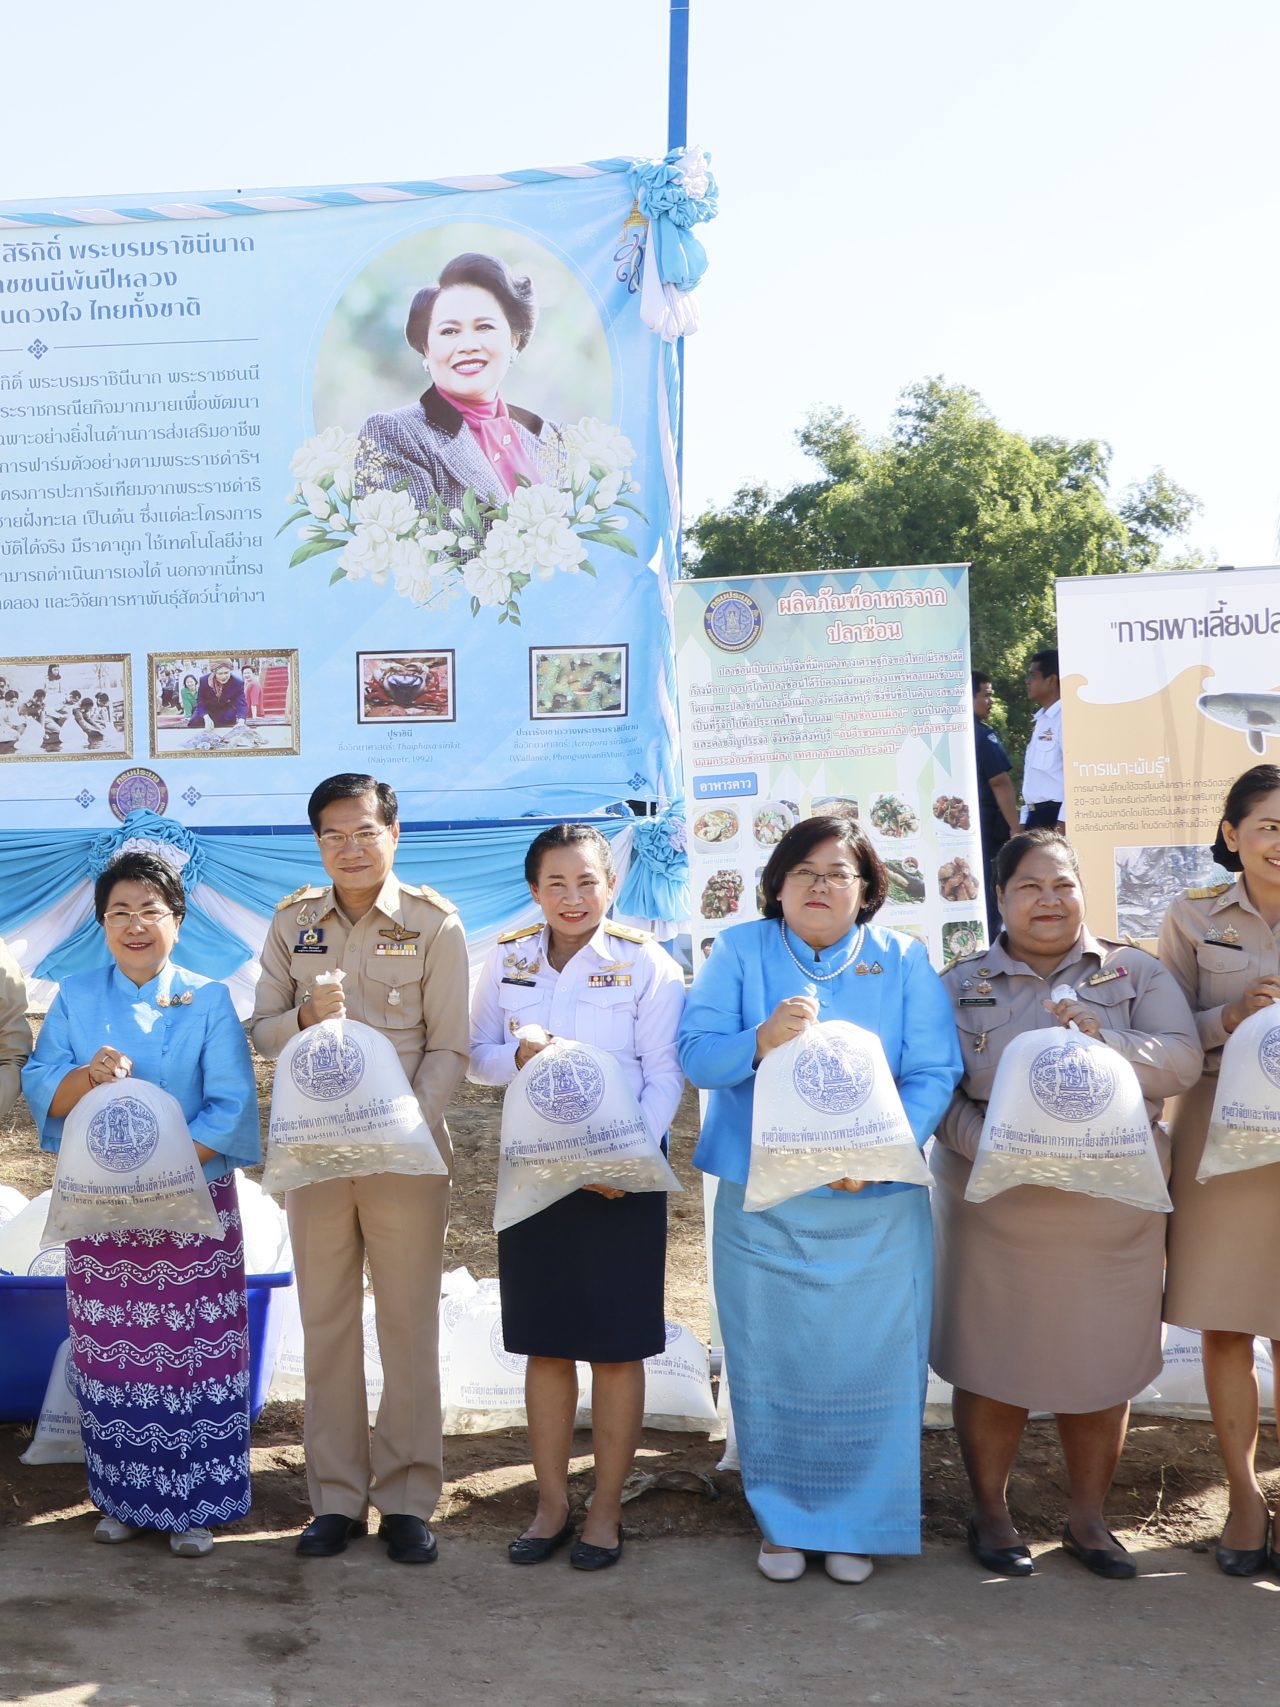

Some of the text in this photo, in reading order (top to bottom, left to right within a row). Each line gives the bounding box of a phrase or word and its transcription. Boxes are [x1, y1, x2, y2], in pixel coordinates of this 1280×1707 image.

[69, 233, 255, 259] พระบรมราชินีนาถ
[90, 292, 201, 320] ไทยทั้งชาติ
[29, 369, 161, 389] พระบรมราชินีนาถ
[169, 364, 260, 384] พระราชชนนี
[83, 508, 134, 524] เป็นต้น
[140, 503, 263, 523] ซึ่งแต่ละโครงการ
[71, 537, 141, 556] มีราคาถูก
[145, 531, 263, 550] ใช้เทคโนโลยีง่าย
[167, 555, 263, 577] นอกจากนี้ทรง
[779, 585, 946, 614] ผลิตภัณฑ์อาหารจาก
[828, 617, 901, 643] ปลาช่อน
[116, 767, 161, 785] กรมประมง
[699, 777, 752, 793] อาหารคาว
